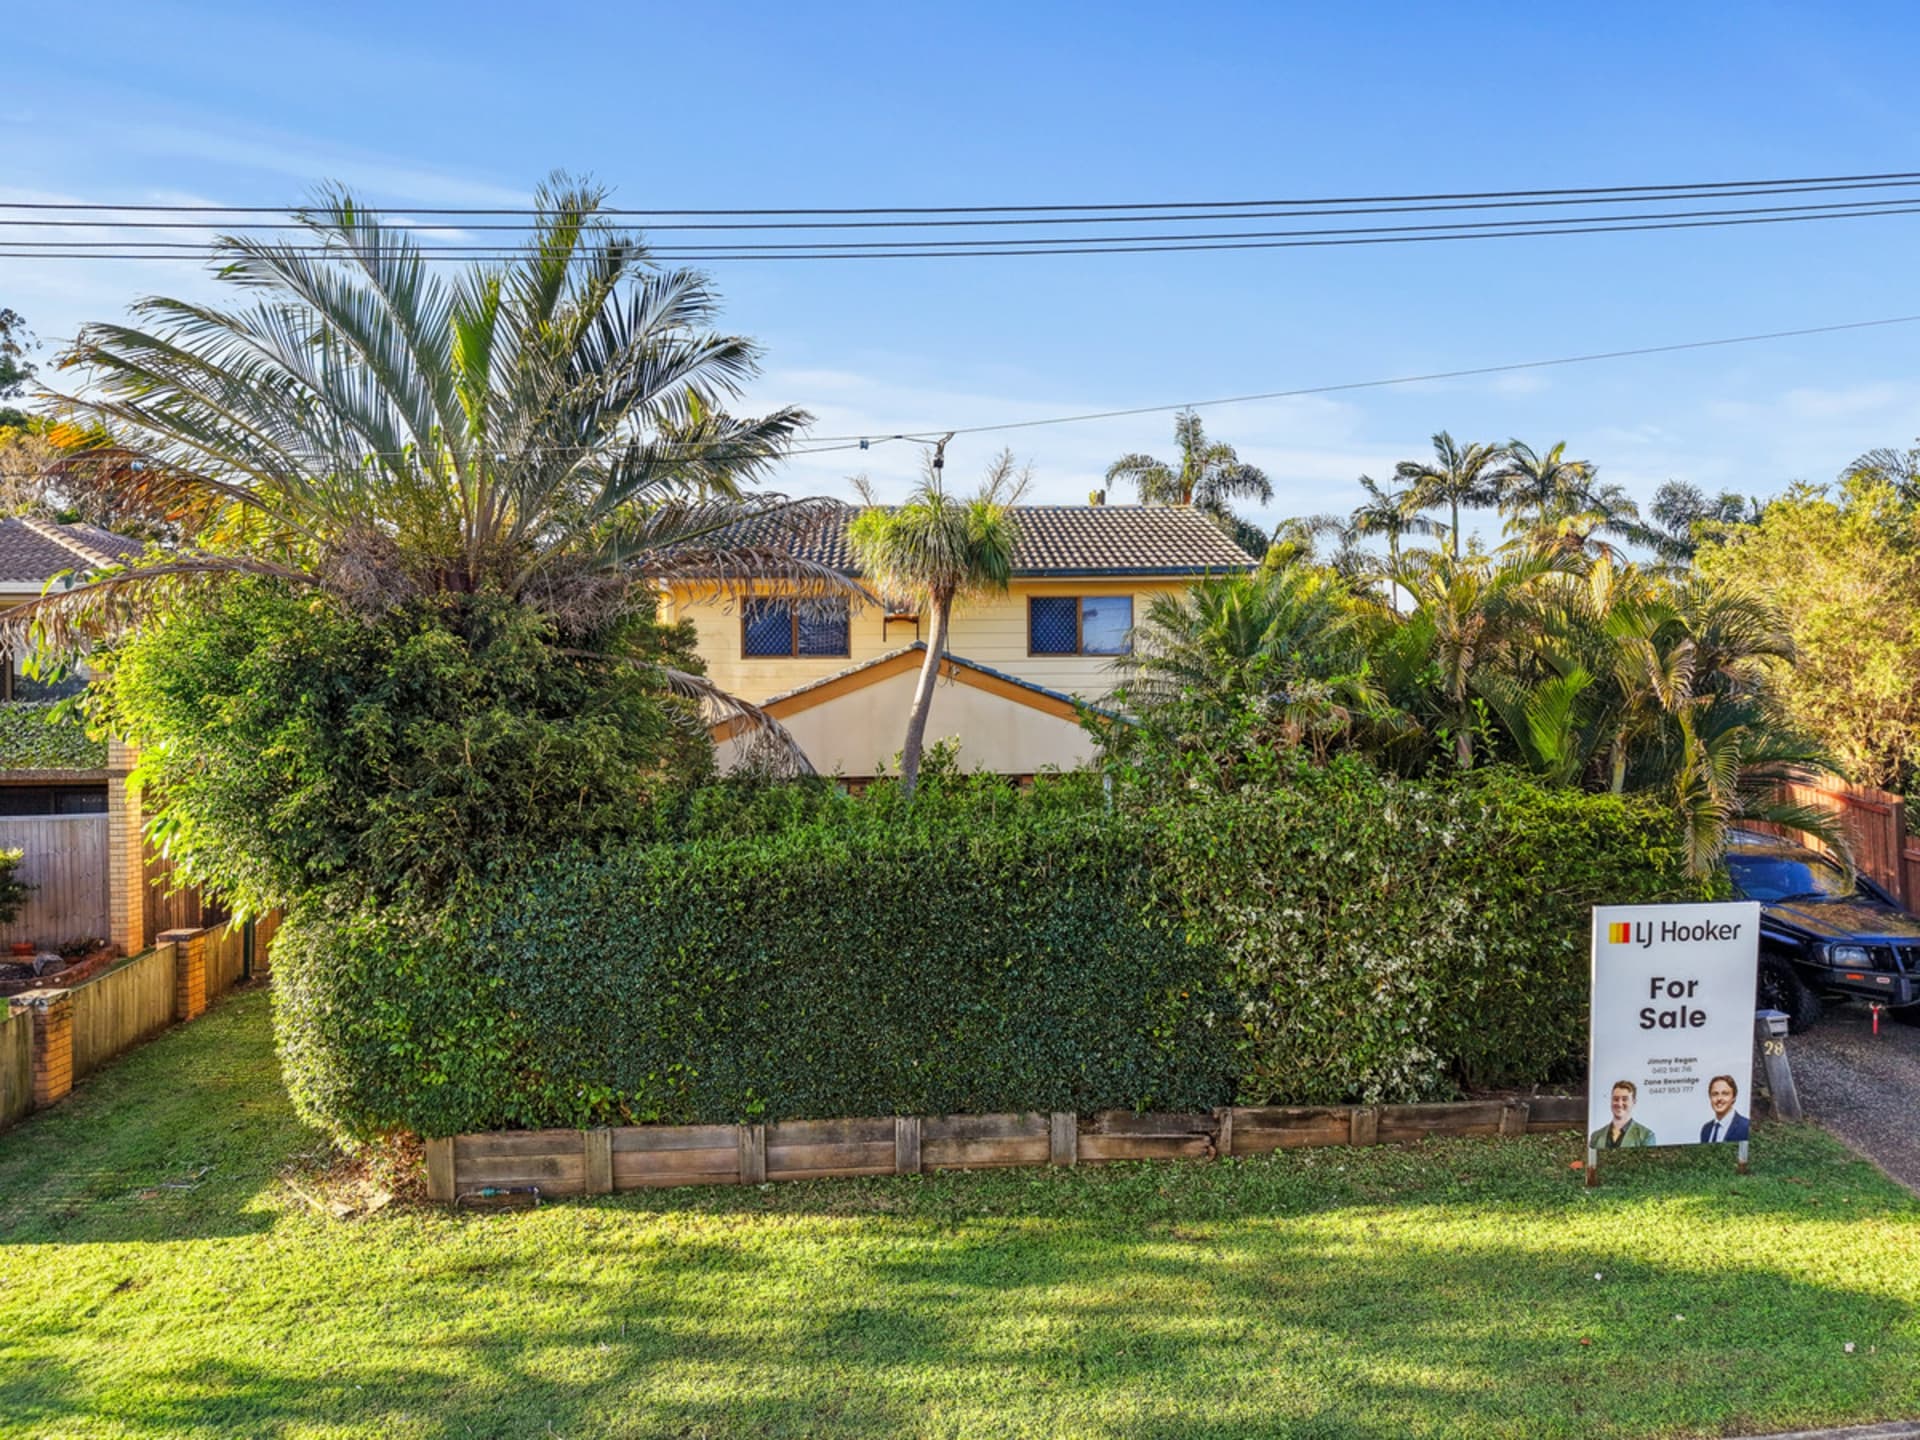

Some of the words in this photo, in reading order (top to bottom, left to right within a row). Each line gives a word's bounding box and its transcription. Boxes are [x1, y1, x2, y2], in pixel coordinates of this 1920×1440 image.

[1636, 921, 1653, 949] LJ
[1661, 919, 1741, 942] Hooker
[1650, 977, 1699, 999] For
[1639, 1005, 1707, 1030] Sale
[1764, 1040, 1784, 1056] 28
